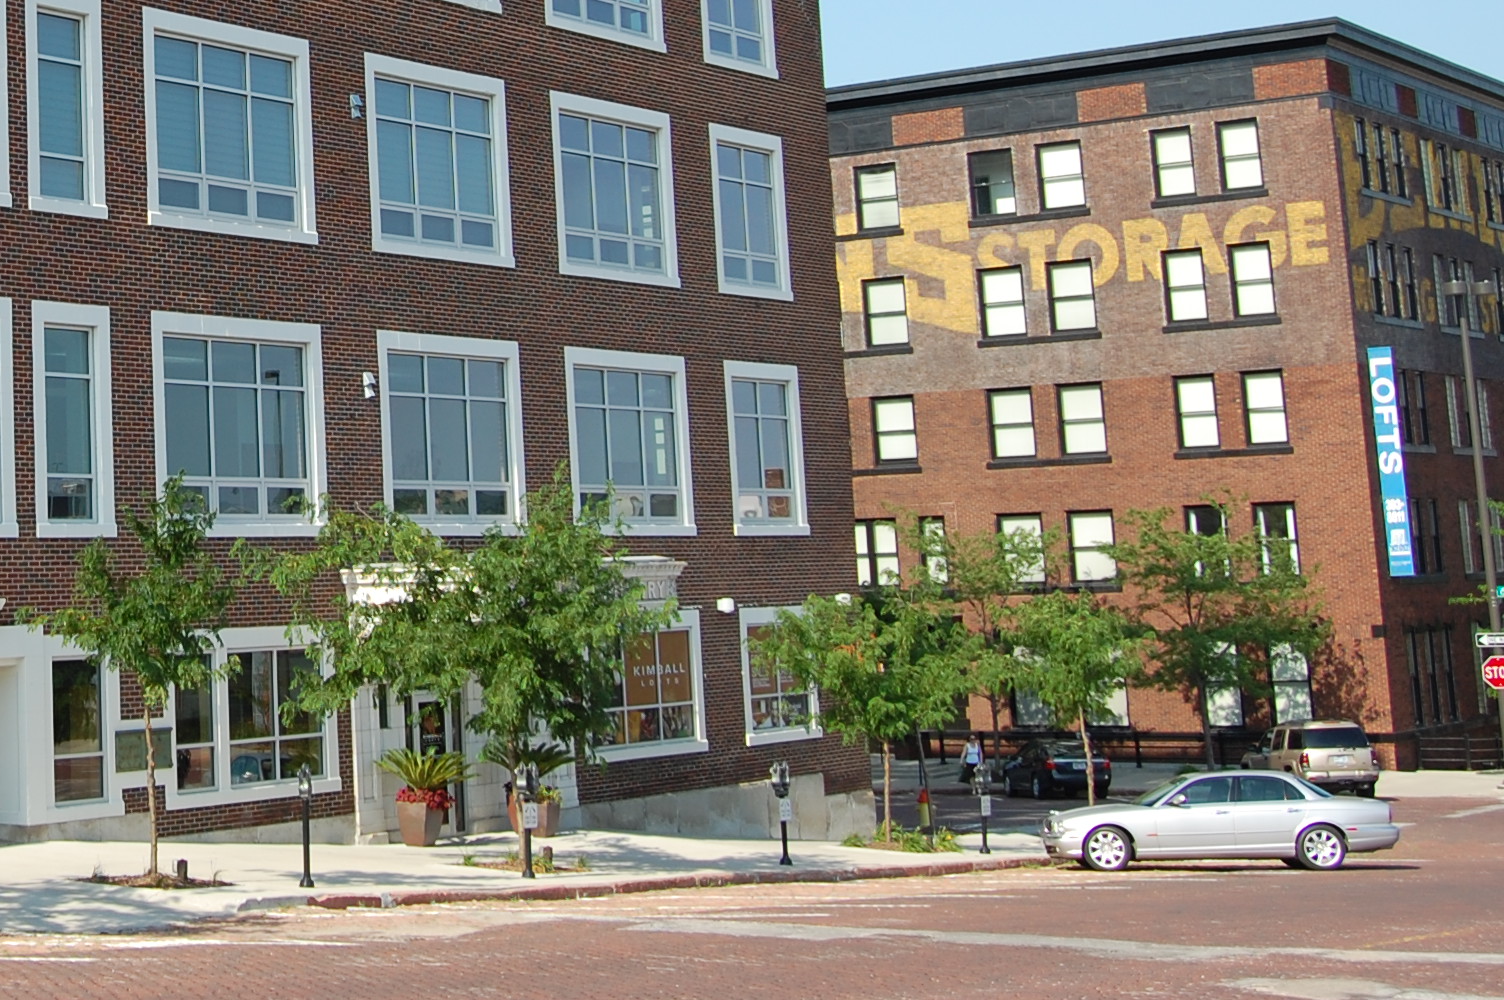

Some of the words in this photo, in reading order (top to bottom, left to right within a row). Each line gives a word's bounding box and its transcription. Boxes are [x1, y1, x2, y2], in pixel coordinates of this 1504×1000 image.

[977, 201, 1330, 292] STORAGE
[1369, 357, 1403, 474] LOFTS
[633, 663, 686, 677] KIMBALL
[641, 677, 680, 687] LOTS
